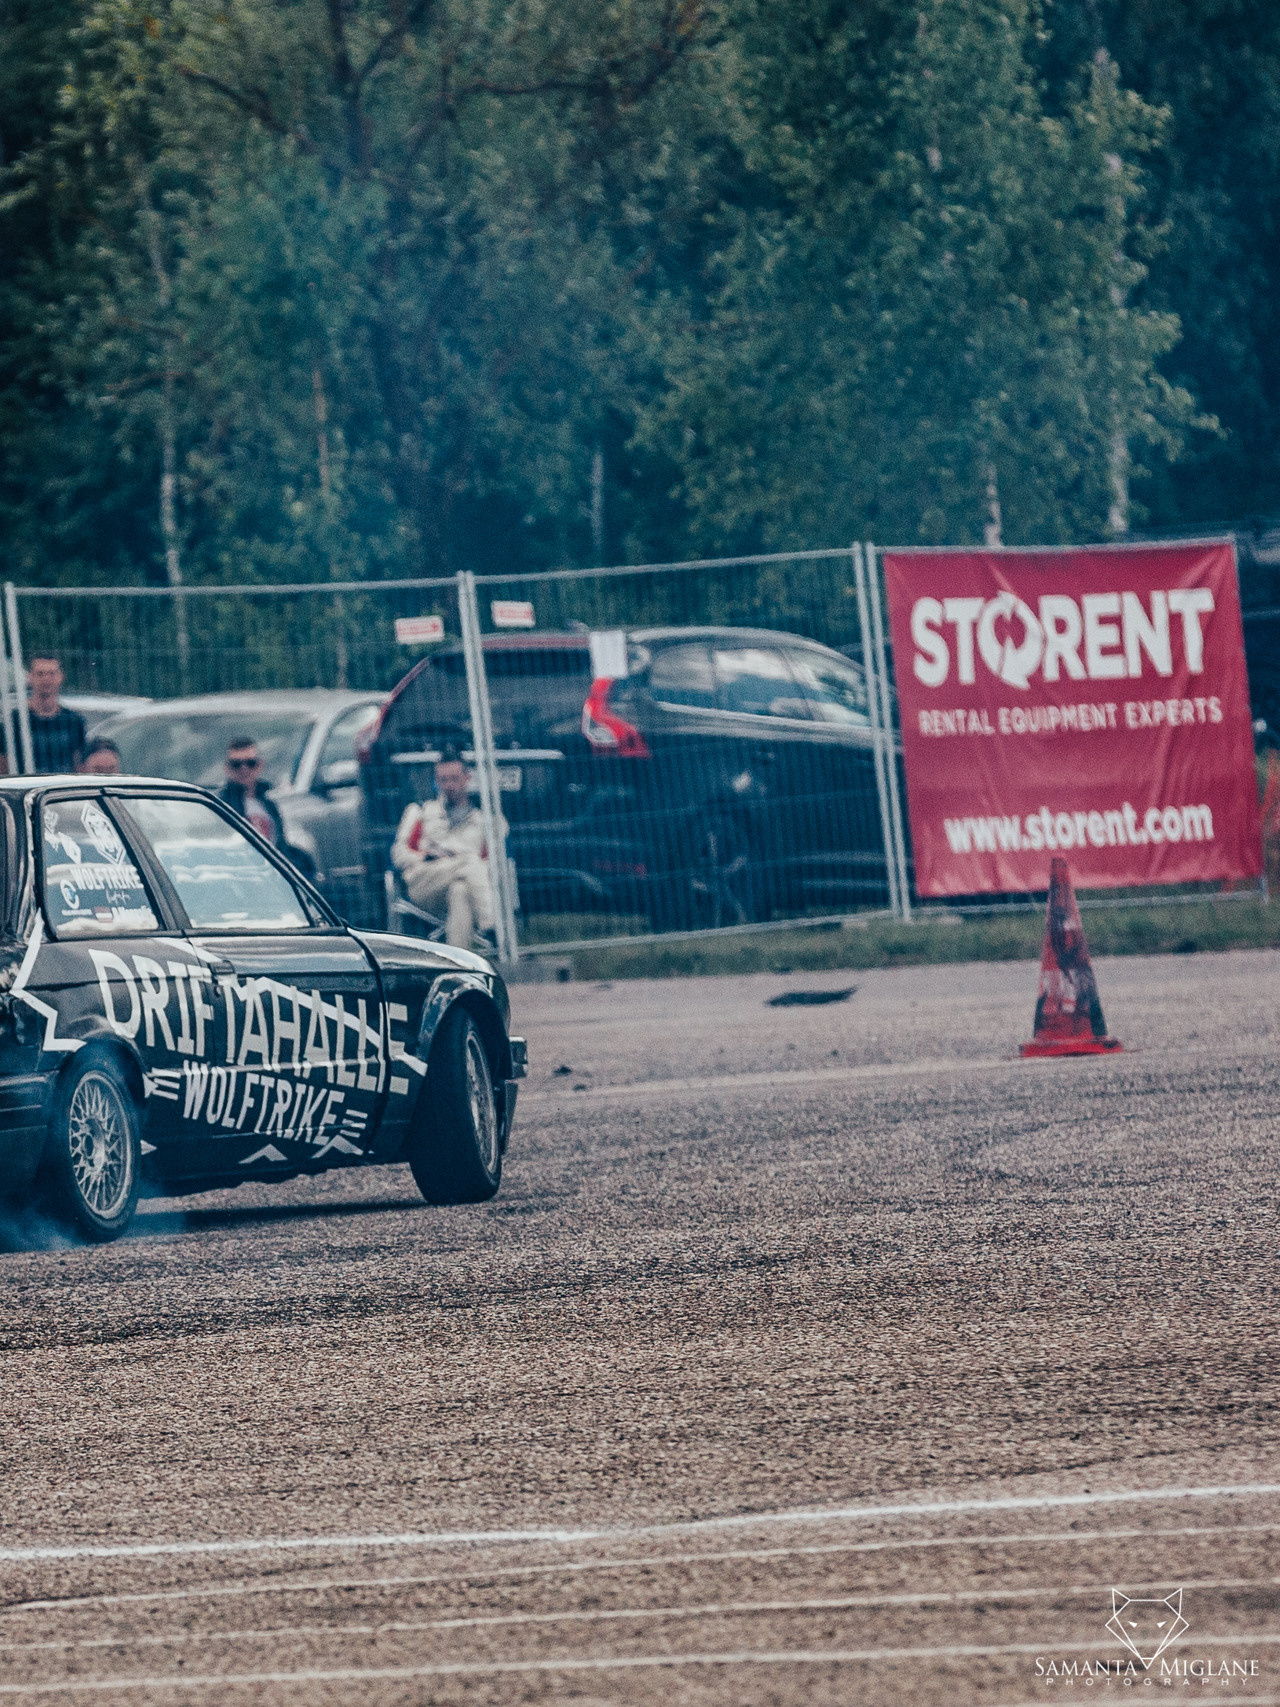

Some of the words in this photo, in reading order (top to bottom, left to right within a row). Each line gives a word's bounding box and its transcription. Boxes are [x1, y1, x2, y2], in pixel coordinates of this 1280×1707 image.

[911, 587, 1215, 690] STORENT
[920, 708, 995, 737] RENTAL
[999, 702, 1118, 736] EQUIPMENT
[1124, 696, 1223, 729] EXPERTS
[943, 801, 1215, 854] www.storent.com
[182, 1059, 345, 1147] WOLFTRIKE
